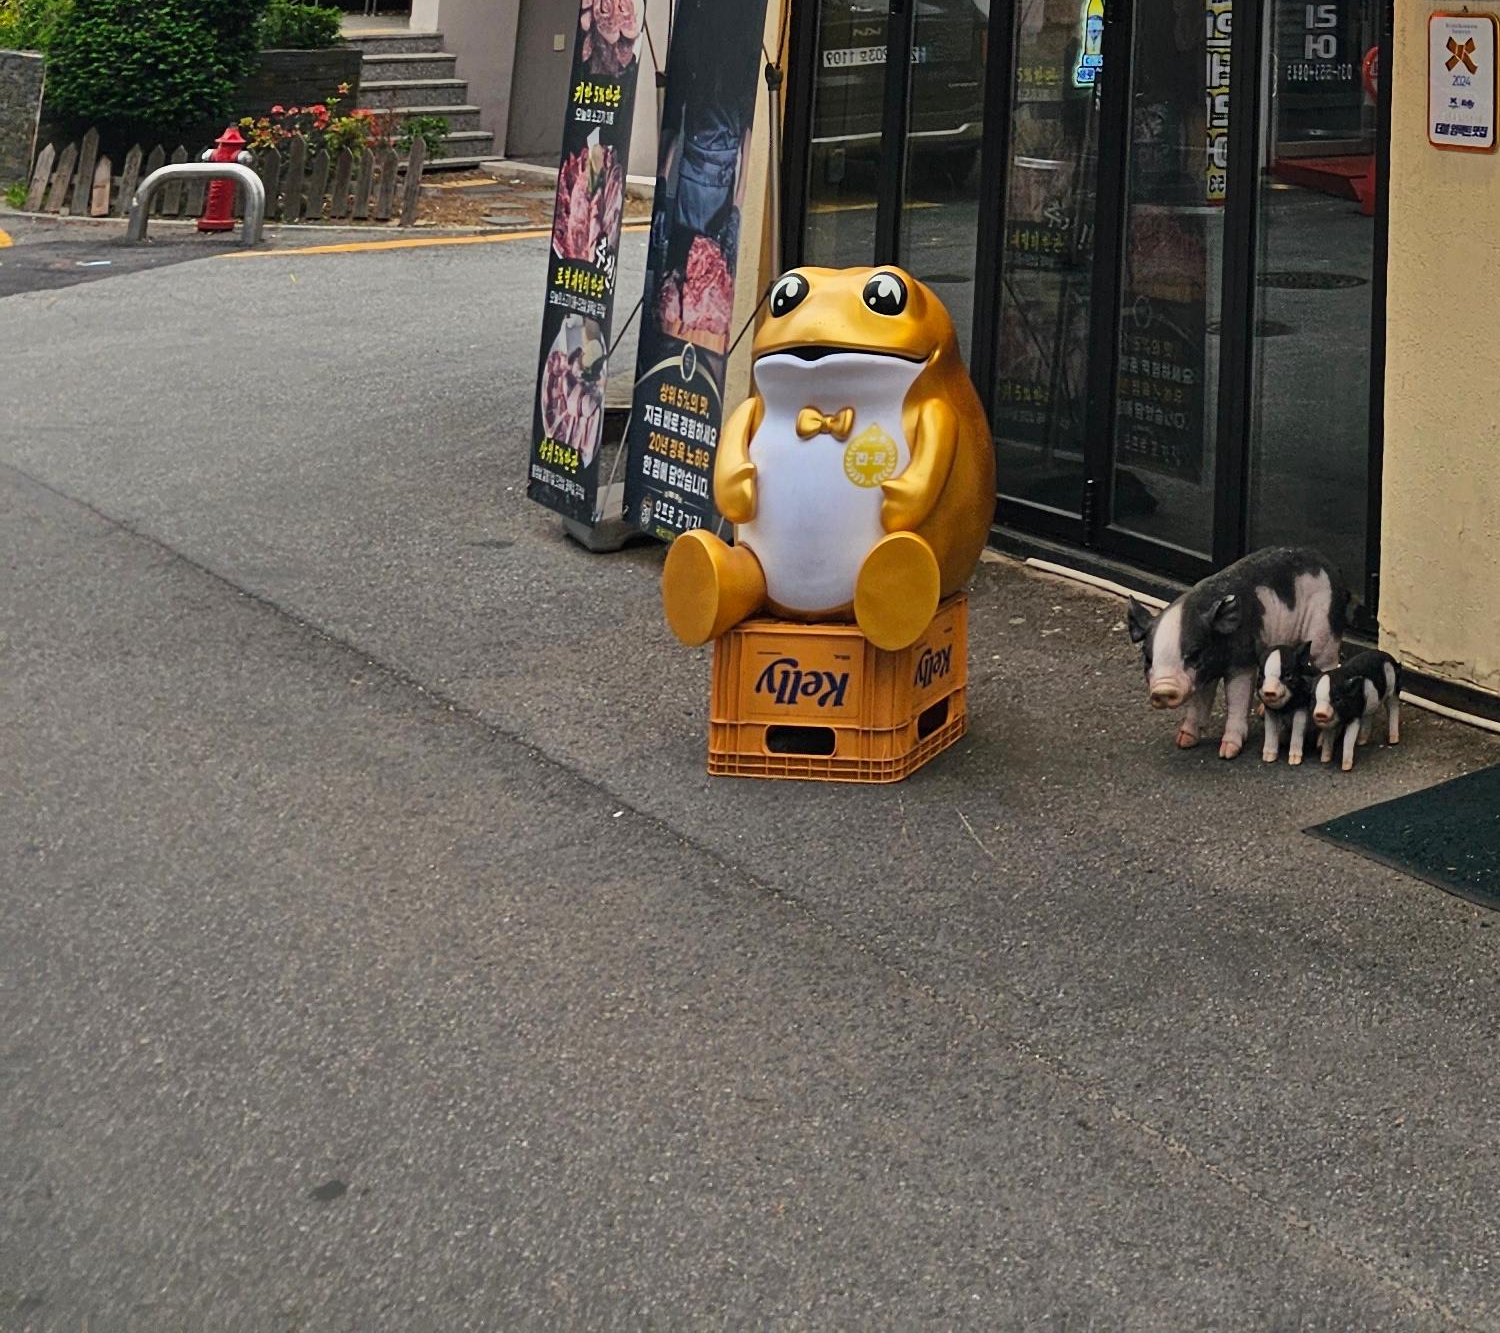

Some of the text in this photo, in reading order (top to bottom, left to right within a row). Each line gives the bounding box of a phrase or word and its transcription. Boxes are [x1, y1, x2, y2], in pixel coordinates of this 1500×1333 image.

[659, 383, 677, 407] 상위
[643, 404, 663, 428] 지금
[648, 431, 670, 455] 20년
[686, 444, 711, 472] 노하우
[653, 500, 675, 525] 오프로
[754, 657, 850, 708] Kelly
[913, 644, 953, 689] Kelly
